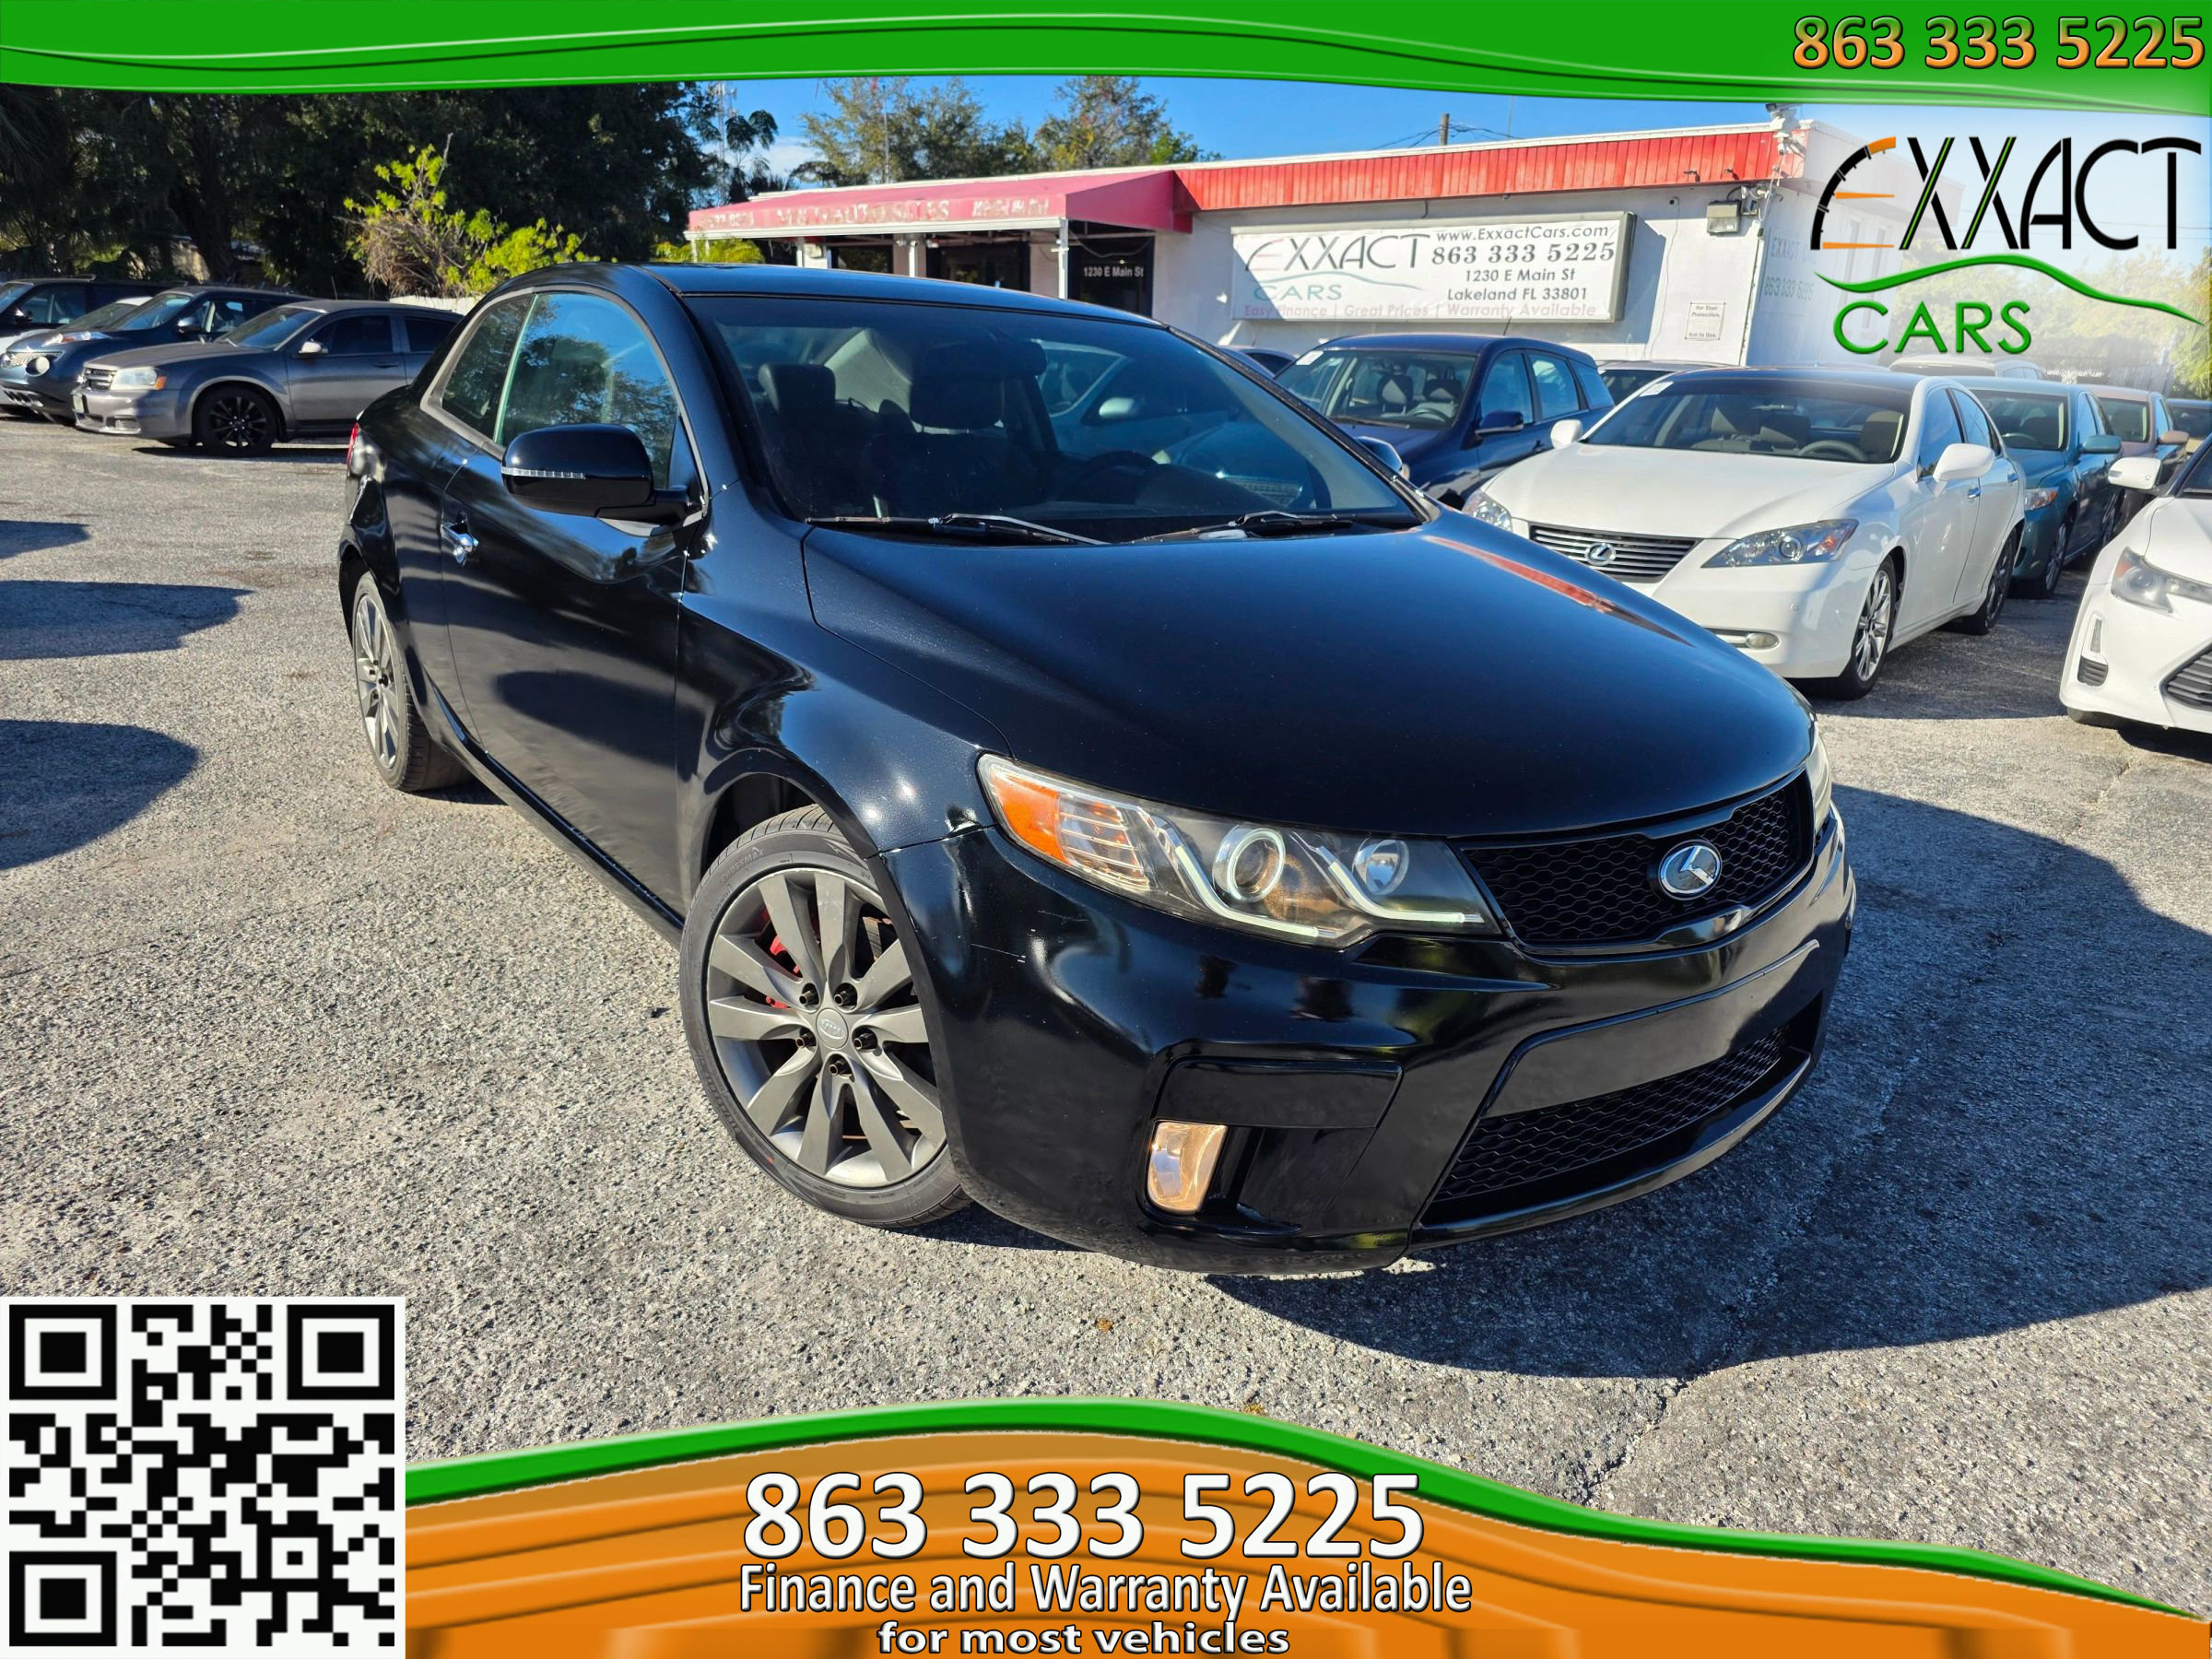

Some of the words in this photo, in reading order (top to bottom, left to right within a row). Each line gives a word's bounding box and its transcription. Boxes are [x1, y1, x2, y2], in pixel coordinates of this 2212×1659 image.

[1436, 225, 1609, 241] www.ExxactCars.com
[1244, 233, 1430, 272] EXXACT
[1431, 245, 1477, 265] 863
[1488, 243, 1536, 264] 333
[1547, 241, 1616, 263] 5225
[1083, 265, 1103, 277] 1230
[1103, 265, 1112, 277] E
[1112, 265, 1133, 277] Main
[1134, 265, 1145, 277] St
[1465, 269, 1500, 282] 1230
[1504, 269, 1512, 282] E
[1517, 268, 1556, 281] Main
[1561, 268, 1576, 281] St
[1253, 284, 1343, 301] CARS
[1447, 288, 1517, 300] Lakeland
[1522, 288, 1537, 300] FL
[1542, 287, 1587, 300] 33801
[1244, 305, 1271, 319] Easy
[1344, 304, 1383, 317] Great
[1387, 304, 1430, 317] Prices
[1446, 303, 1512, 319] Warranty
[1519, 302, 1597, 318] Available
